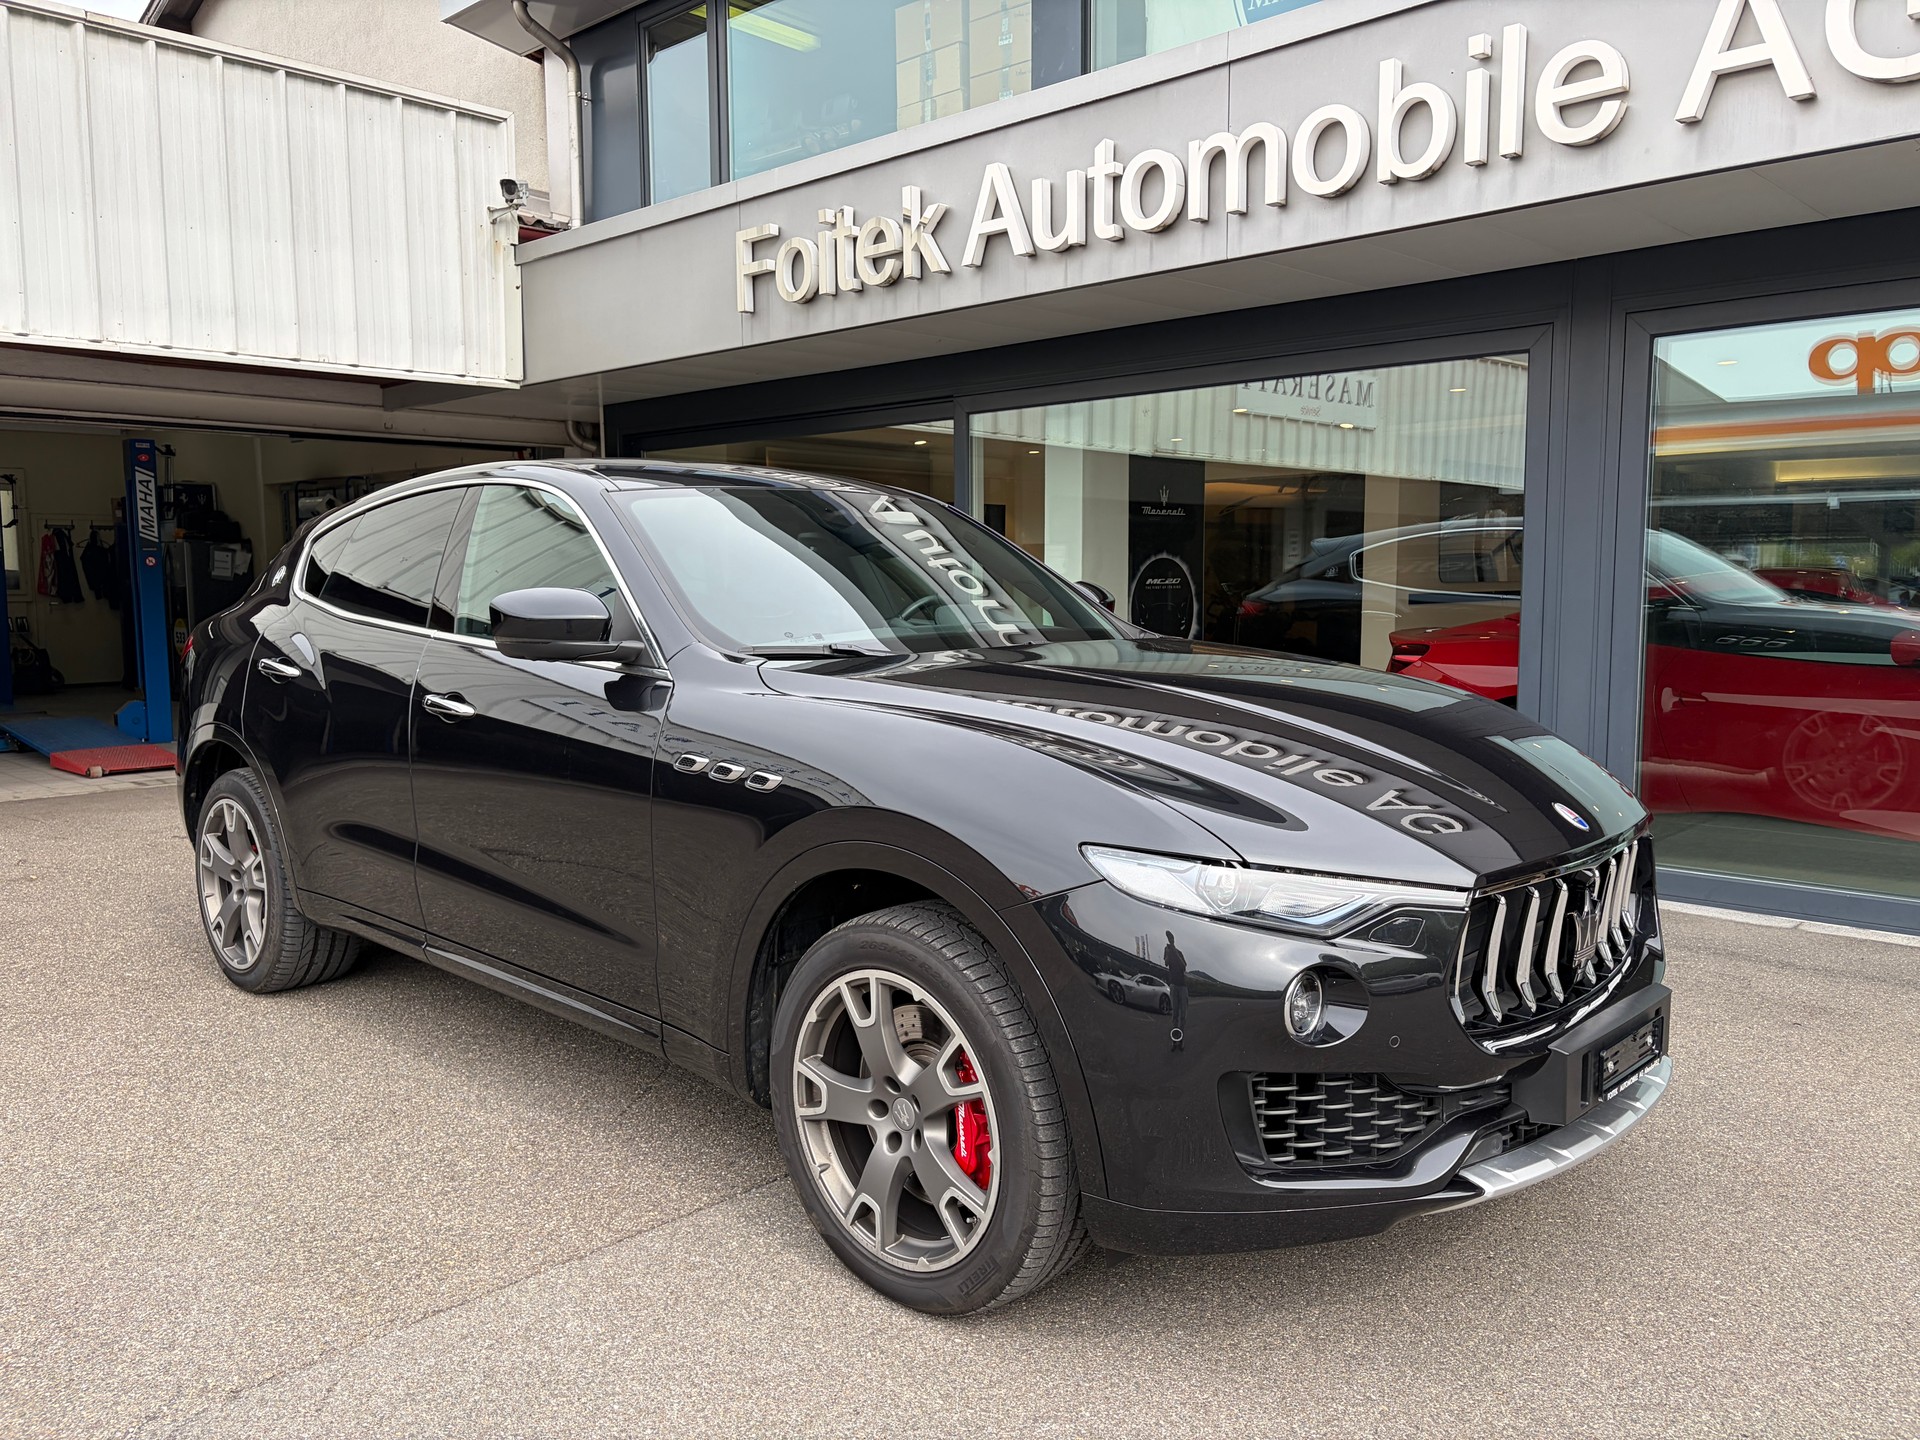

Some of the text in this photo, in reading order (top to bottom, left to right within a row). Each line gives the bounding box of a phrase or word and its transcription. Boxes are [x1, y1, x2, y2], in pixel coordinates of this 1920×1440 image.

[736, 0, 1920, 313] Foitek Automobile AG
[138, 478, 156, 534] MAHA
[1141, 506, 1186, 516] Maserati
[1145, 577, 1181, 585] MC20
[958, 1102, 968, 1158] Maserati
